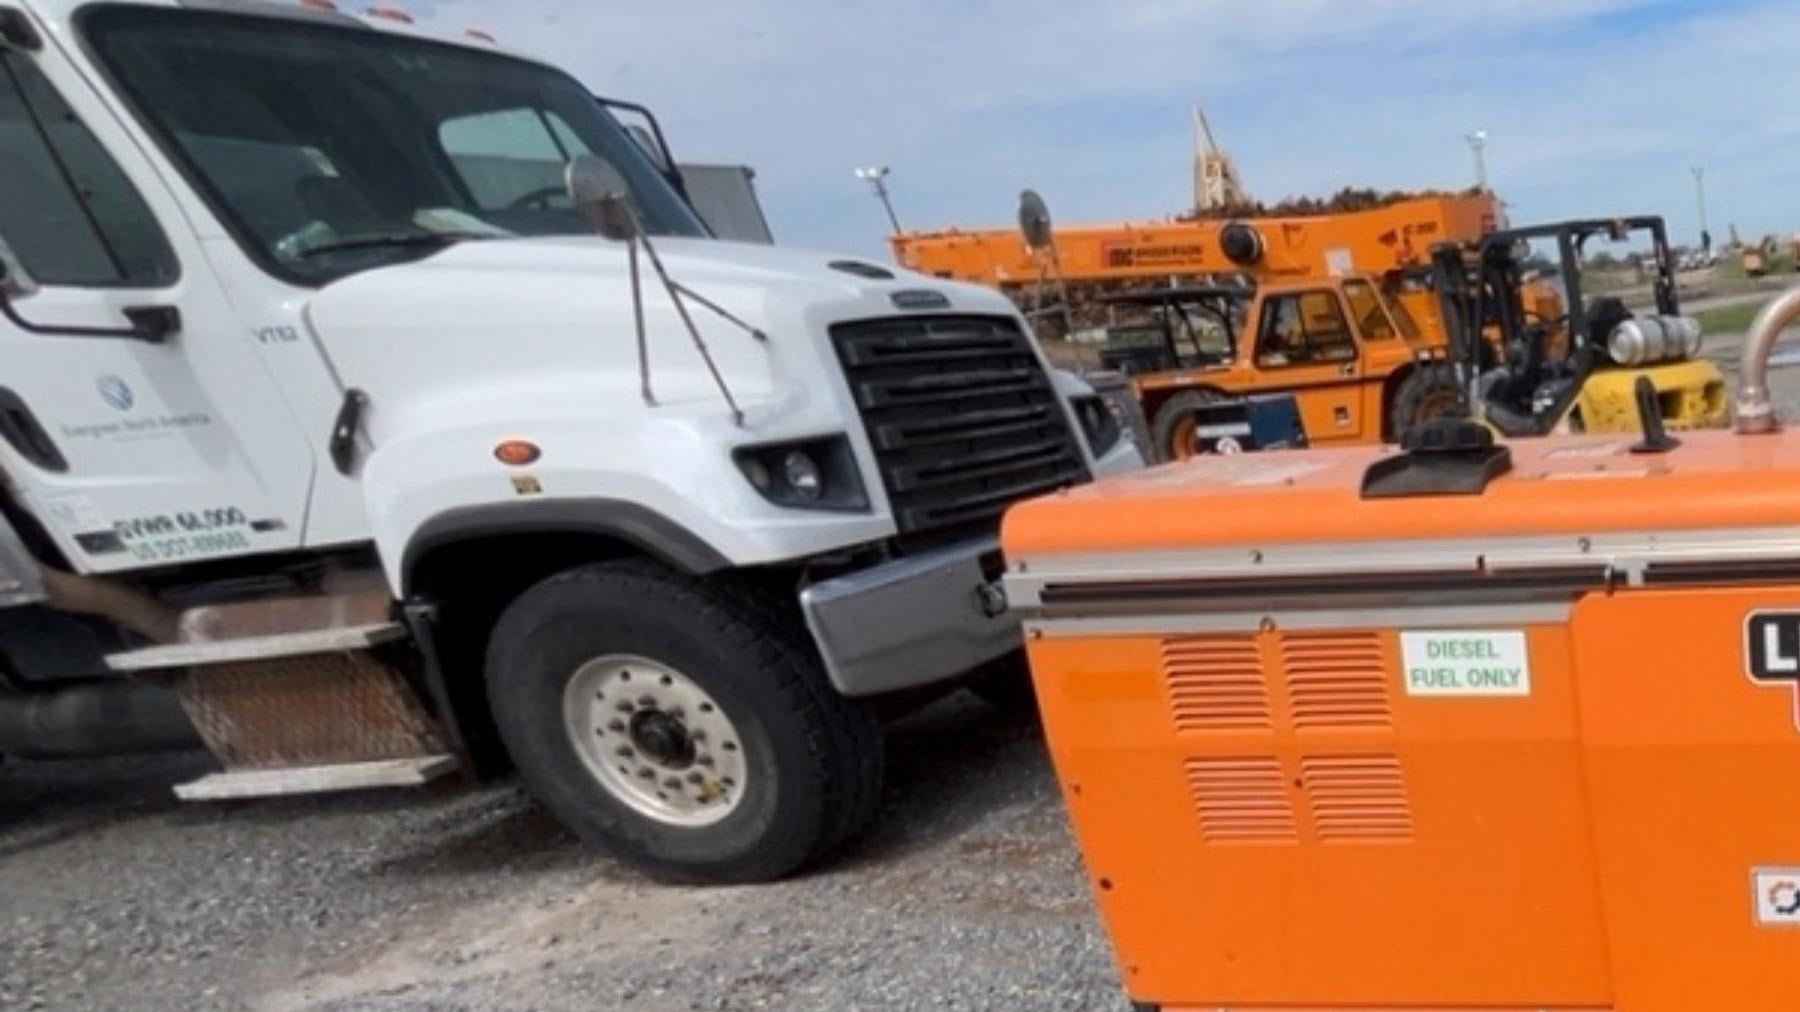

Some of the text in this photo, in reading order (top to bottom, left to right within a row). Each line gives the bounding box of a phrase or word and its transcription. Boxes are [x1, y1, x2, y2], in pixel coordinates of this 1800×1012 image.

[1427, 639, 1501, 658] DIESEL
[1411, 667, 1521, 688] FUEL ONLY
